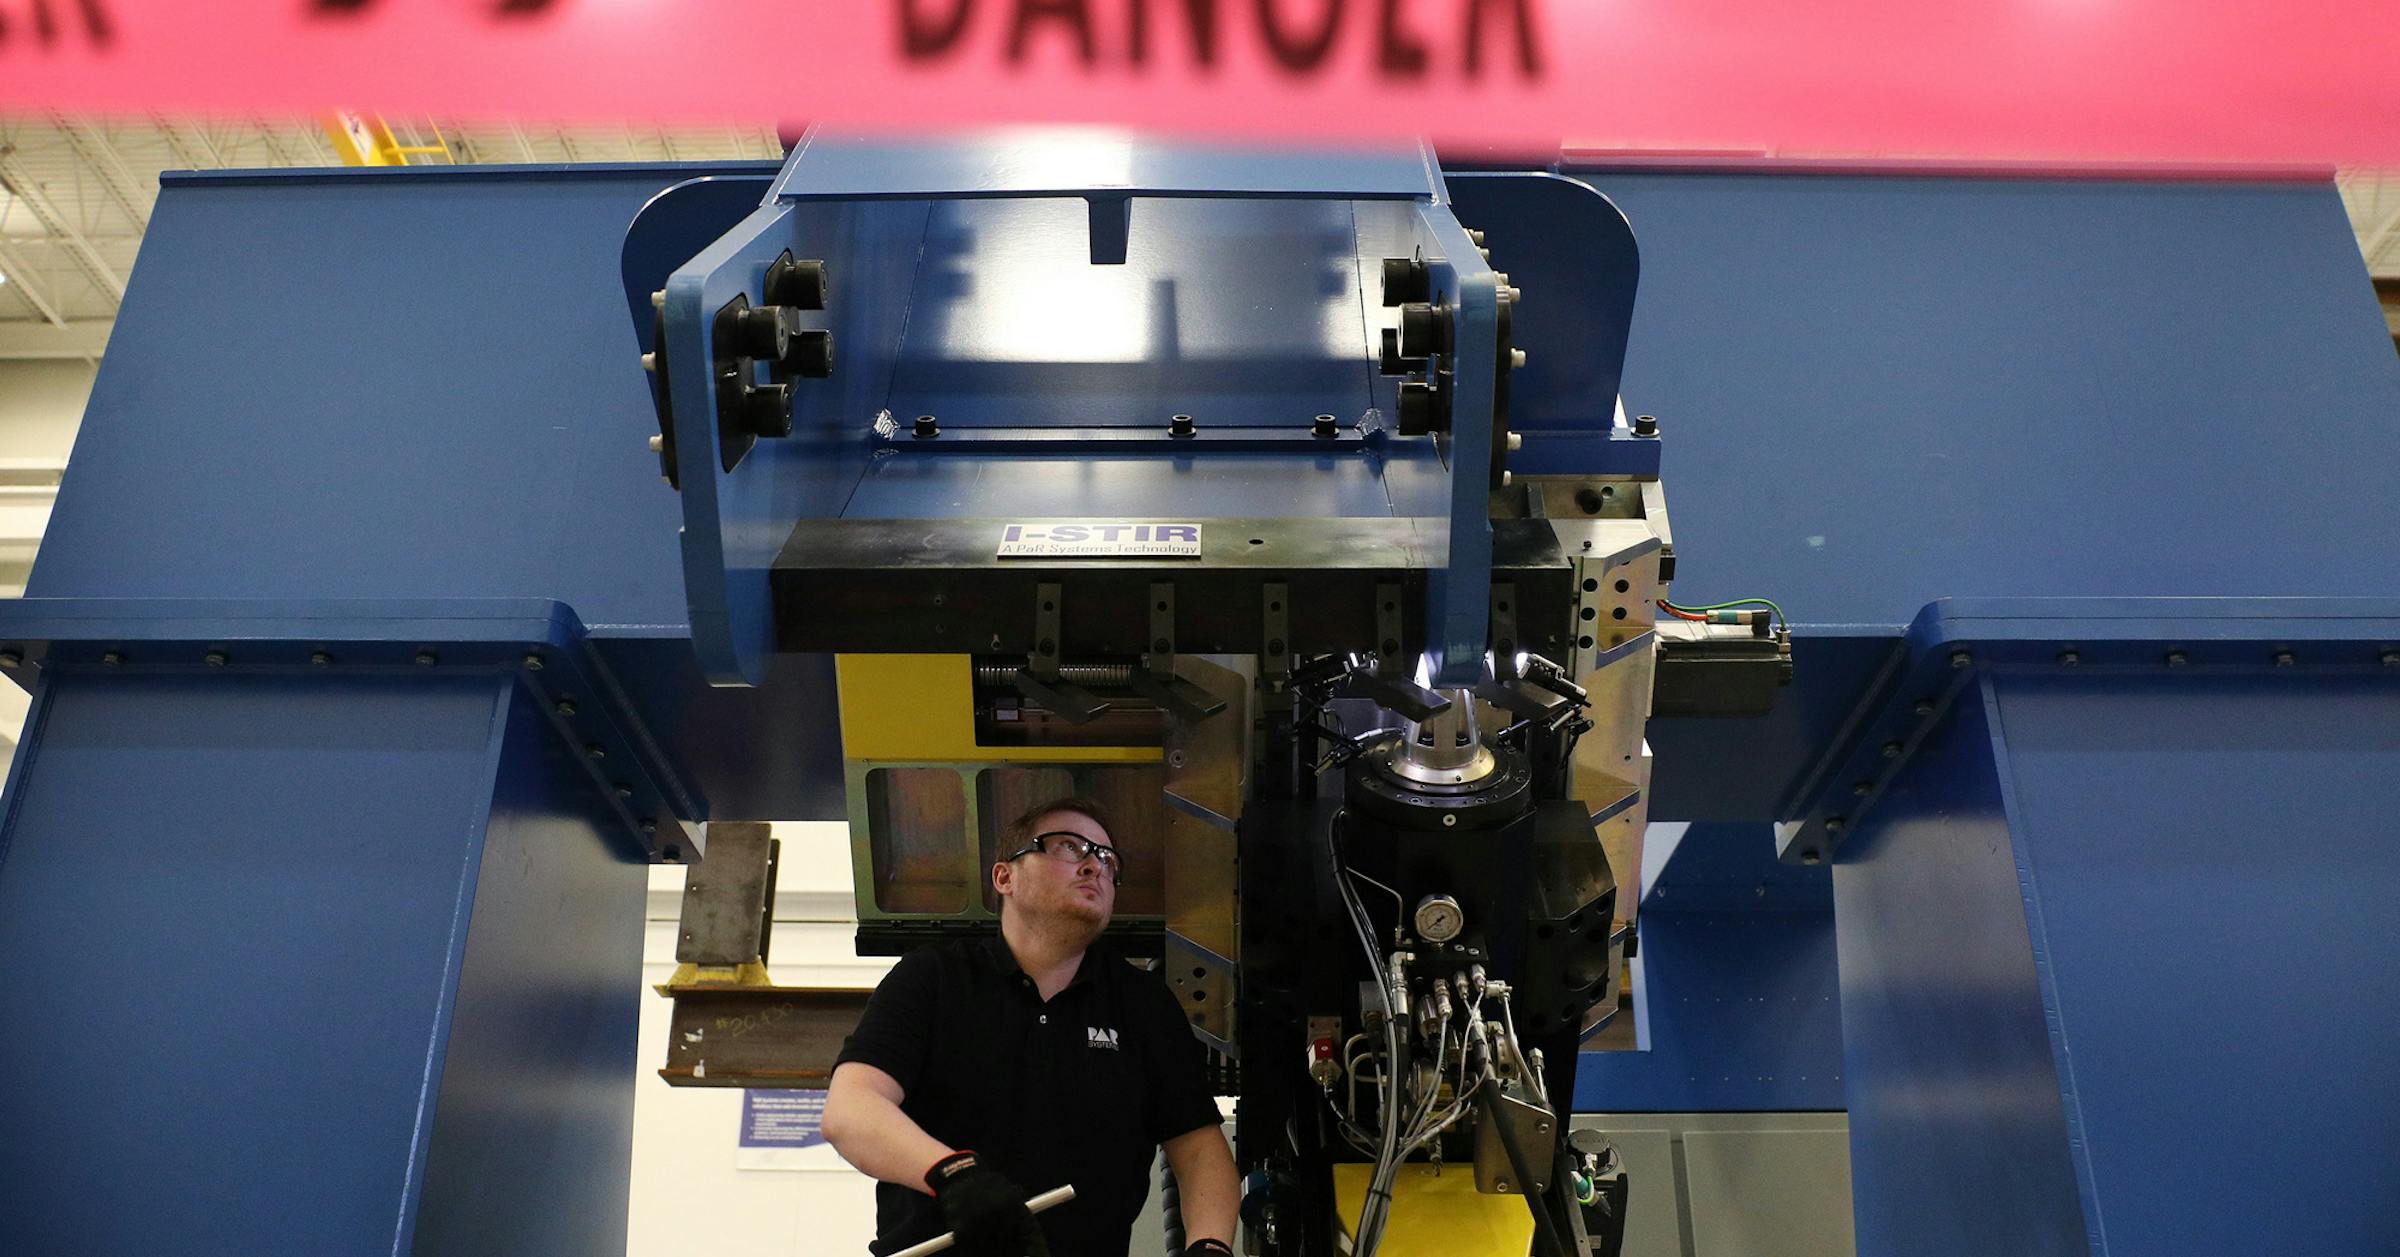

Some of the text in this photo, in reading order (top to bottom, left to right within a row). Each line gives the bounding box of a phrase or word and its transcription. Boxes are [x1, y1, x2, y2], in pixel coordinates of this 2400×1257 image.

[1004, 525, 1198, 542] I-STIR
[1002, 544, 1198, 554] A PaR Systems Technology
